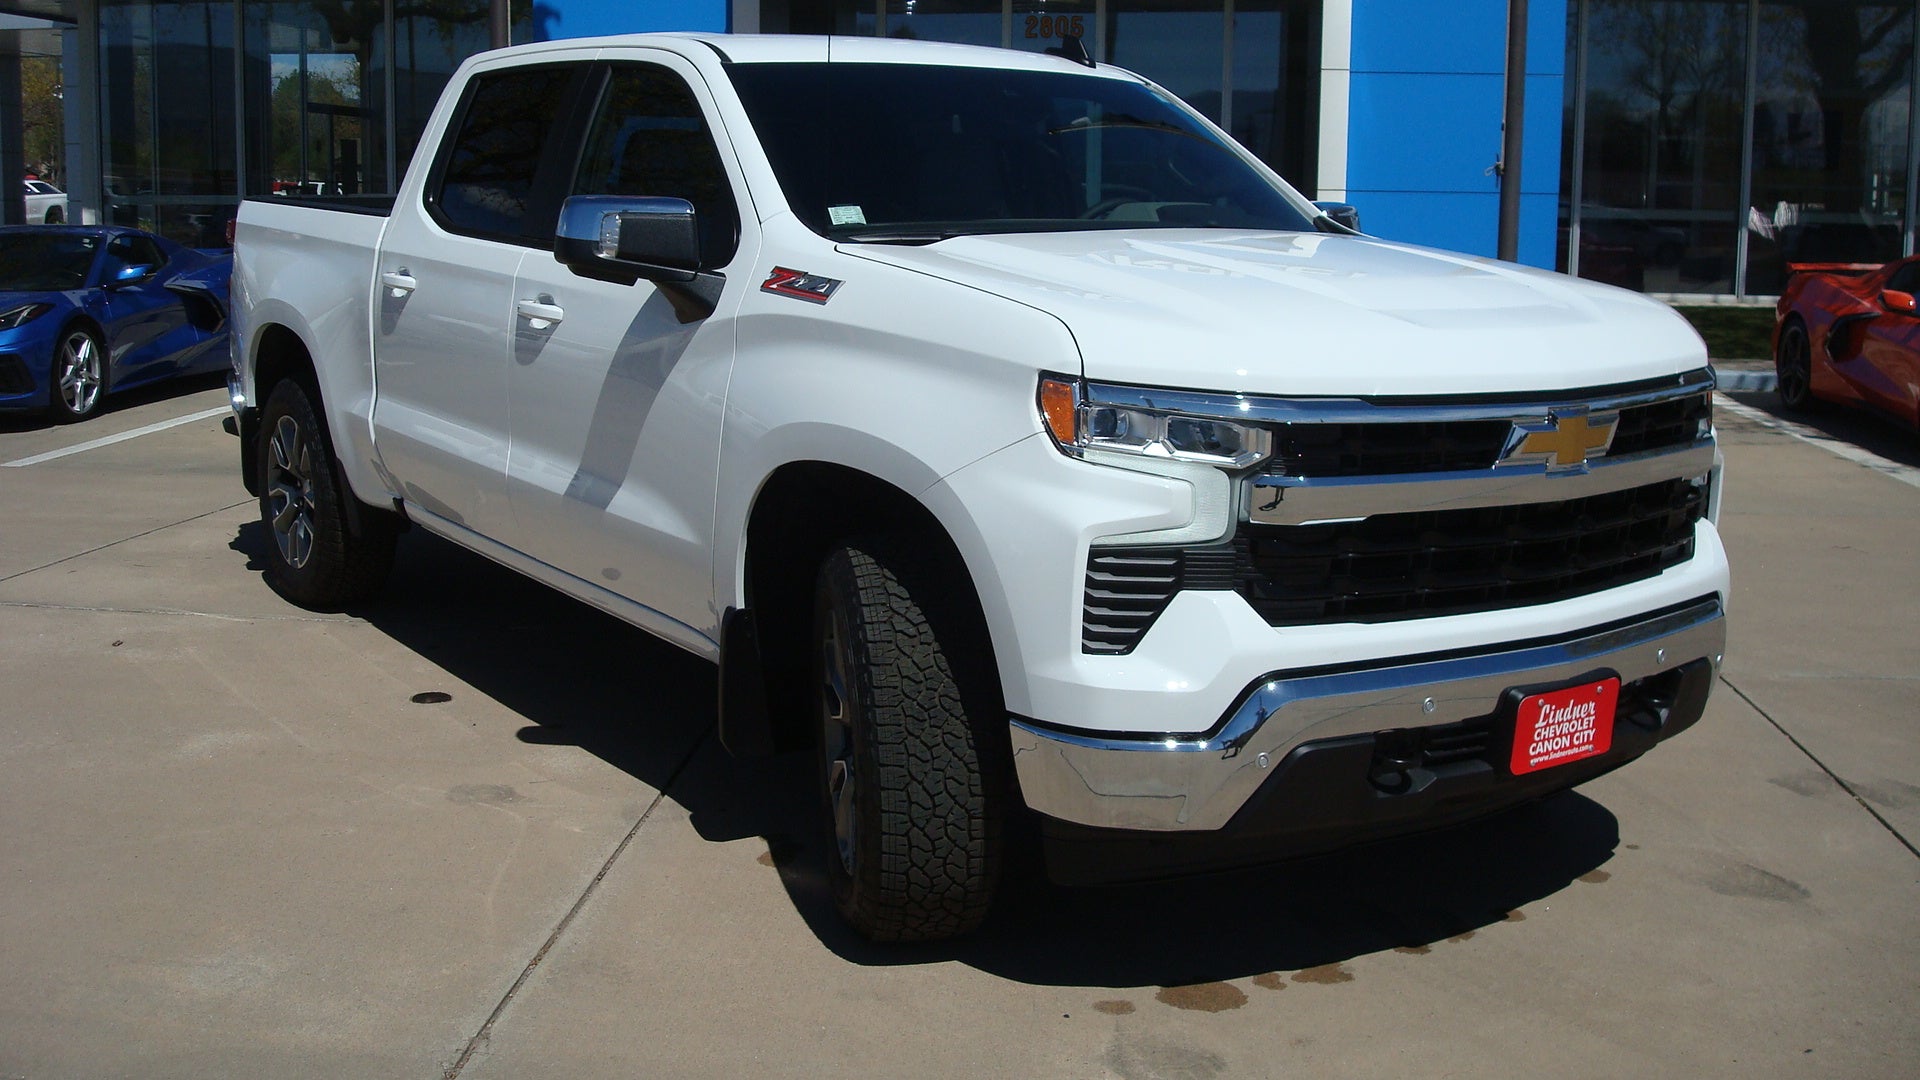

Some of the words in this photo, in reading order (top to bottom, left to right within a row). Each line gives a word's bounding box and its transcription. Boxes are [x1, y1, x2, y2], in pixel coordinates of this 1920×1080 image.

[1024, 15, 1084, 39] 2805
[1535, 699, 1595, 728] Lindner
[1534, 716, 1595, 741] CHEVROLET
[1529, 735, 1571, 756] CANON
[1573, 729, 1596, 745] CITY
